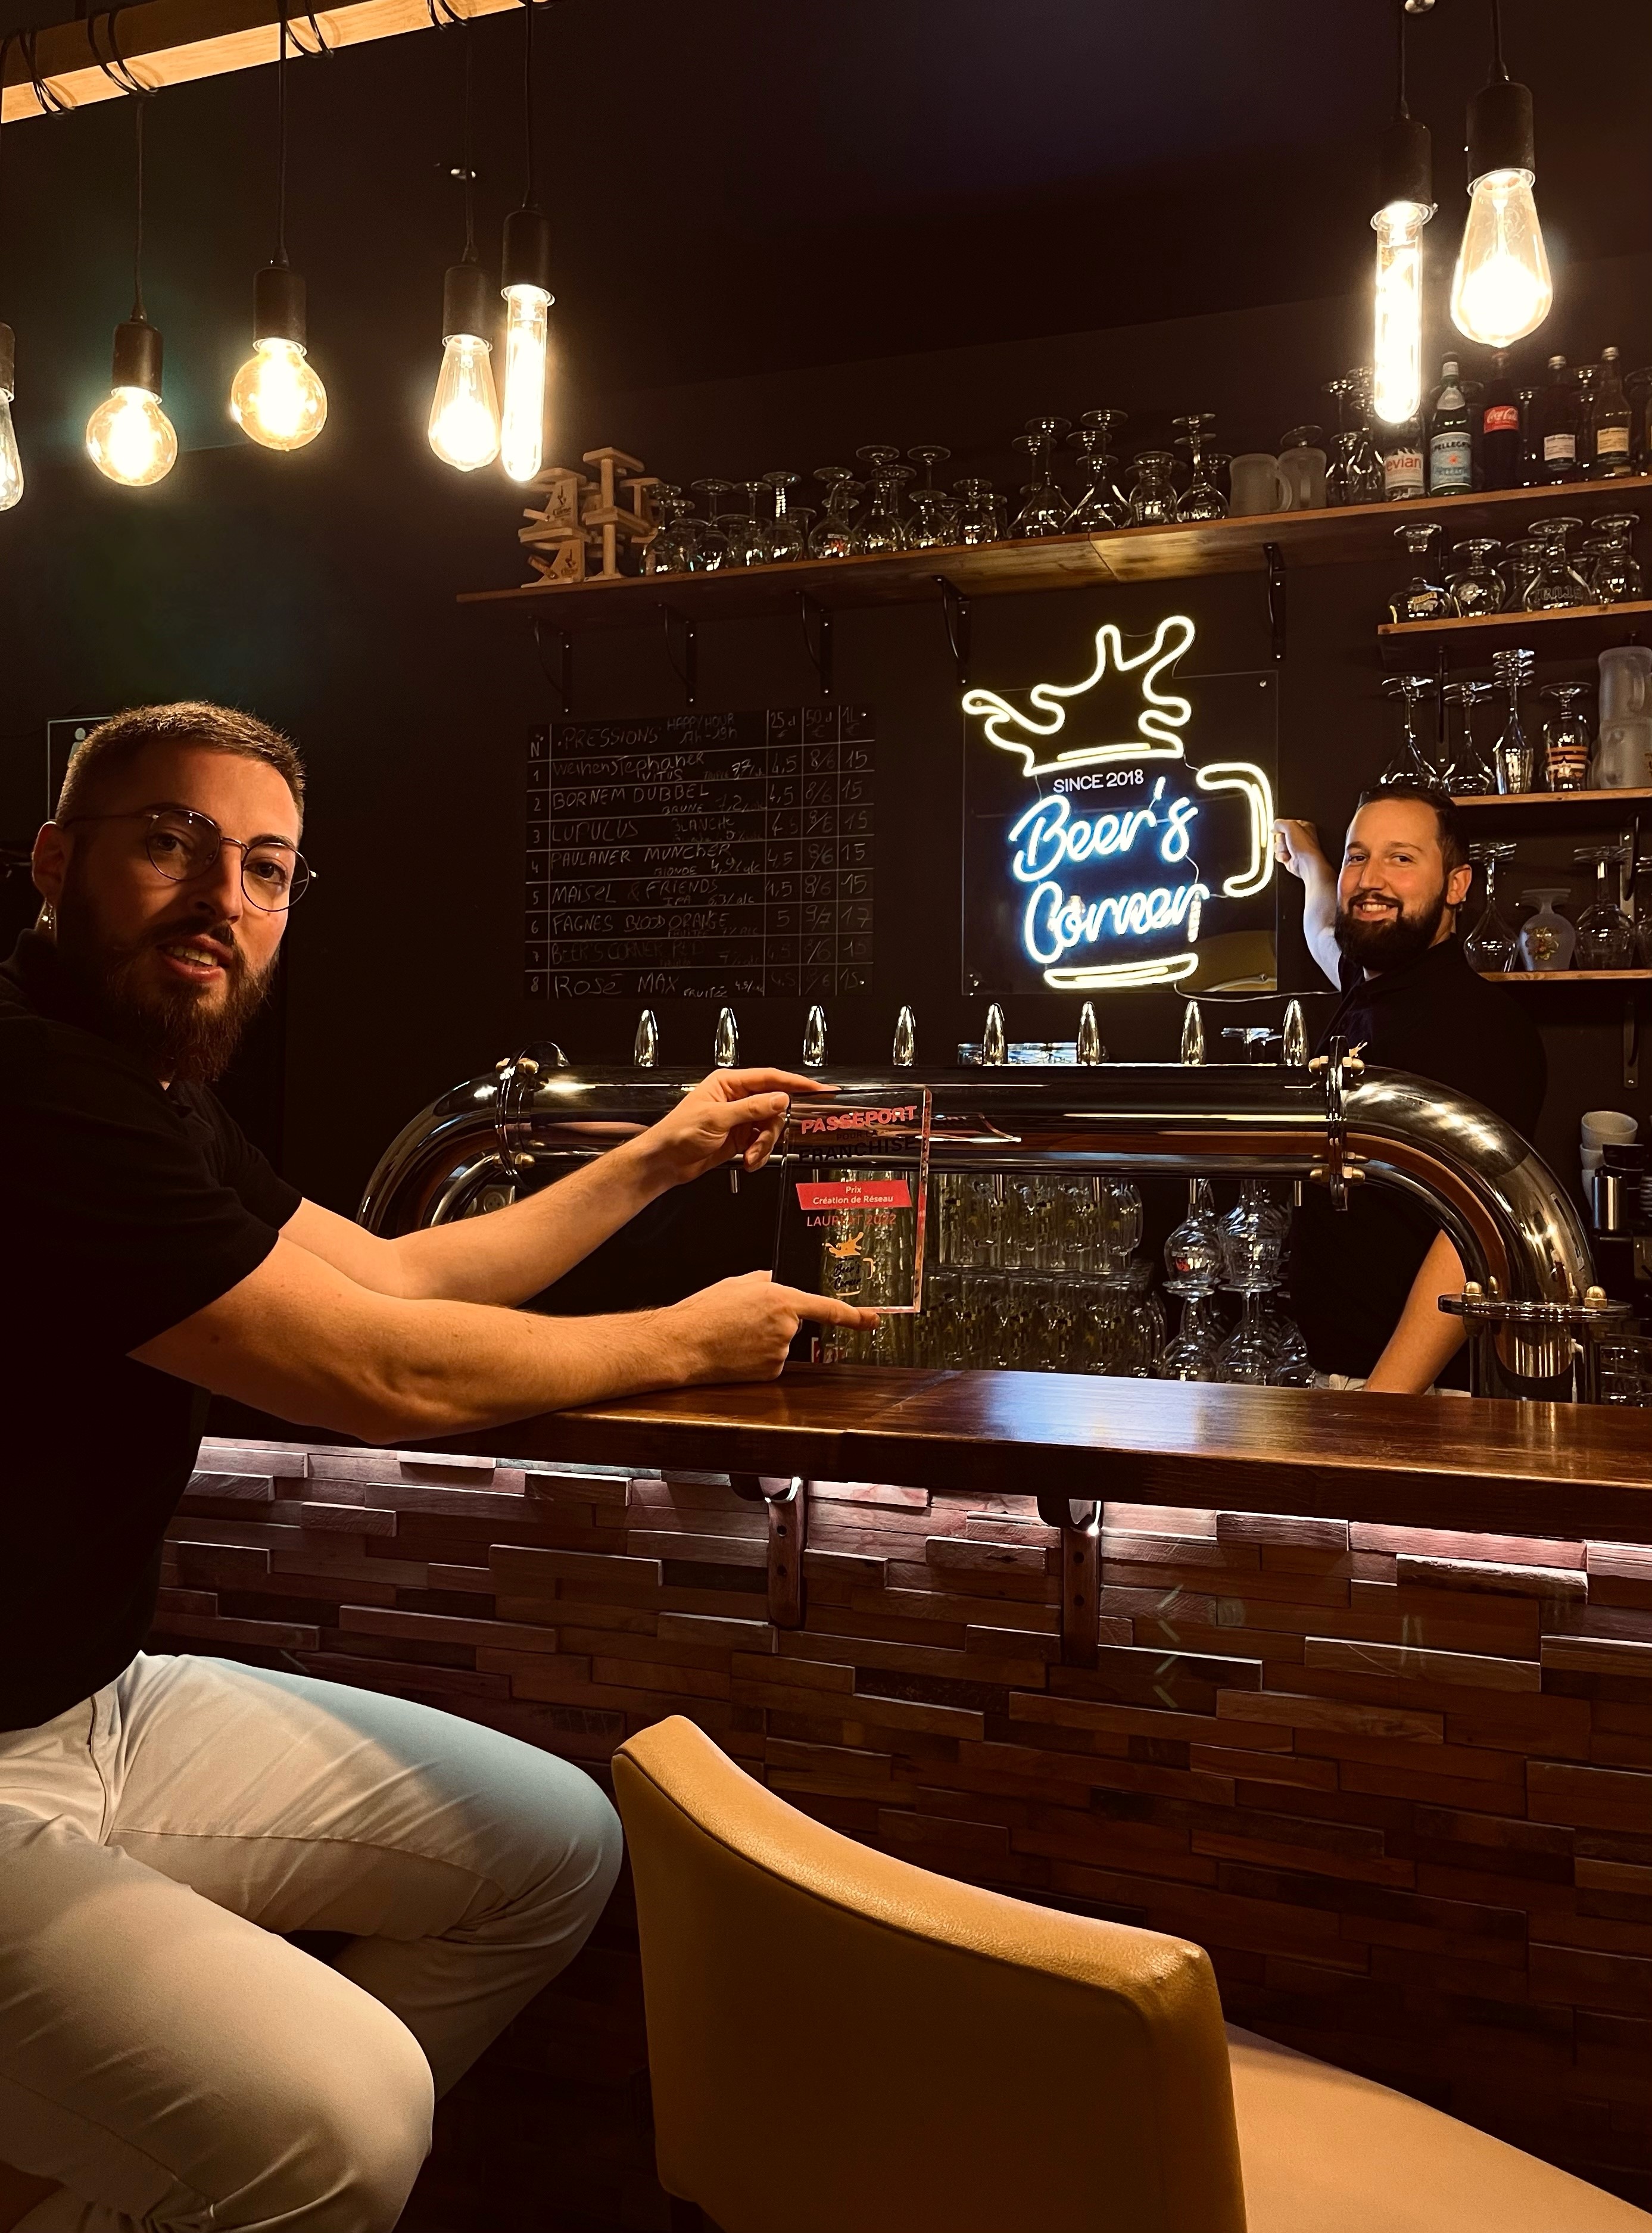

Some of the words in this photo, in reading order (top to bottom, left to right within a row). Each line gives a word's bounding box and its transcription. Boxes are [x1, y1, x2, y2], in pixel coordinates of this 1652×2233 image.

[1386, 456, 1422, 472] evian
[845, 749, 868, 769] 15
[533, 769, 539, 782] 1
[1053, 775, 1104, 794] SINCE
[1106, 769, 1144, 789] 2018
[841, 779, 863, 800] 15
[534, 797, 541, 812] 2
[844, 810, 868, 829] 15
[533, 829, 540, 844] 3
[1008, 776, 1199, 882] Beer's
[841, 843, 866, 861] 15
[531, 860, 538, 874] 4
[532, 890, 540, 906] 5
[552, 912, 614, 935] FAGNES
[776, 910, 790, 927] 5
[1024, 881, 1210, 963] Corner
[531, 921, 539, 934] 6
[531, 976, 540, 993] 8
[638, 972, 681, 994] MAX
[801, 1105, 917, 1134] PASSEPORT
[836, 1131, 862, 1141] POUR
[798, 1136, 916, 1163] FRANCHISE
[846, 1186, 862, 1194] Prix
[813, 1196, 849, 1205] Création
[863, 1195, 893, 1203] Réseau
[865, 1213, 897, 1227] 2022
